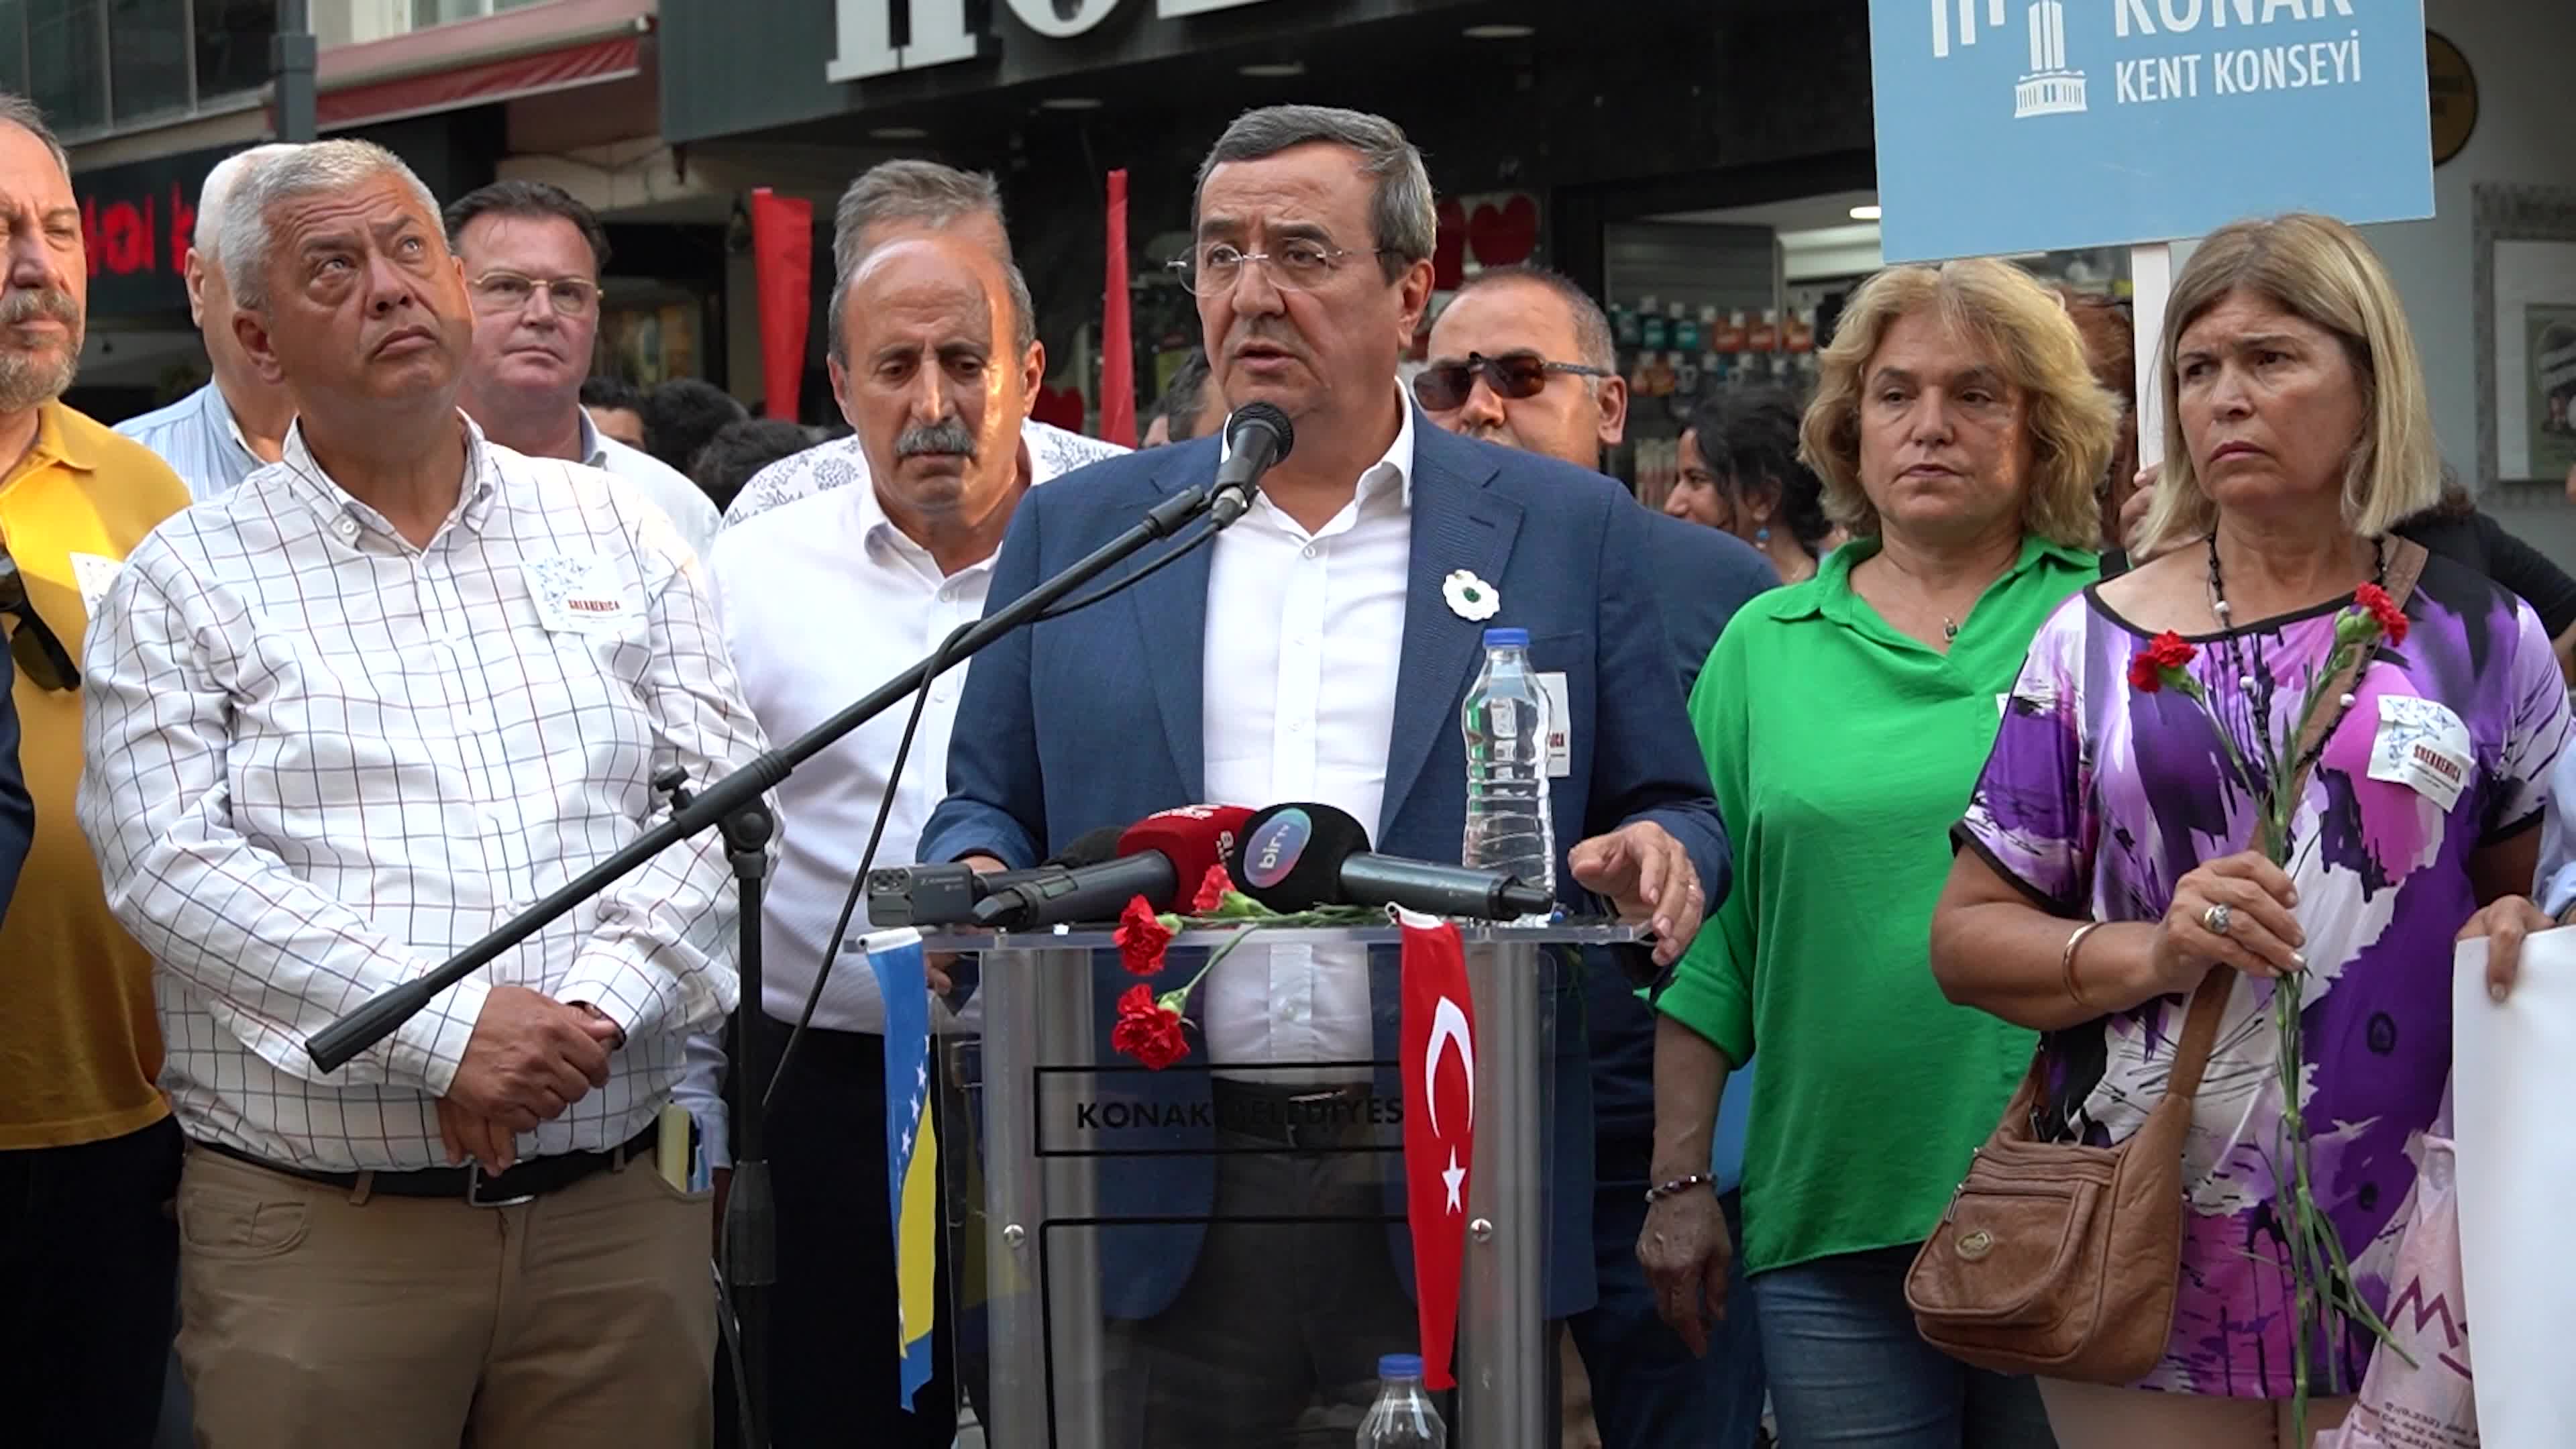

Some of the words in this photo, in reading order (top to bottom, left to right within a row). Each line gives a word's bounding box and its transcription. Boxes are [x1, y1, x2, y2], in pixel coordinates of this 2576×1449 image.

[2115, 54, 2202, 104] KENT
[2214, 29, 2361, 95] KONSEYİ
[1077, 1102, 1216, 1128] KONAK
